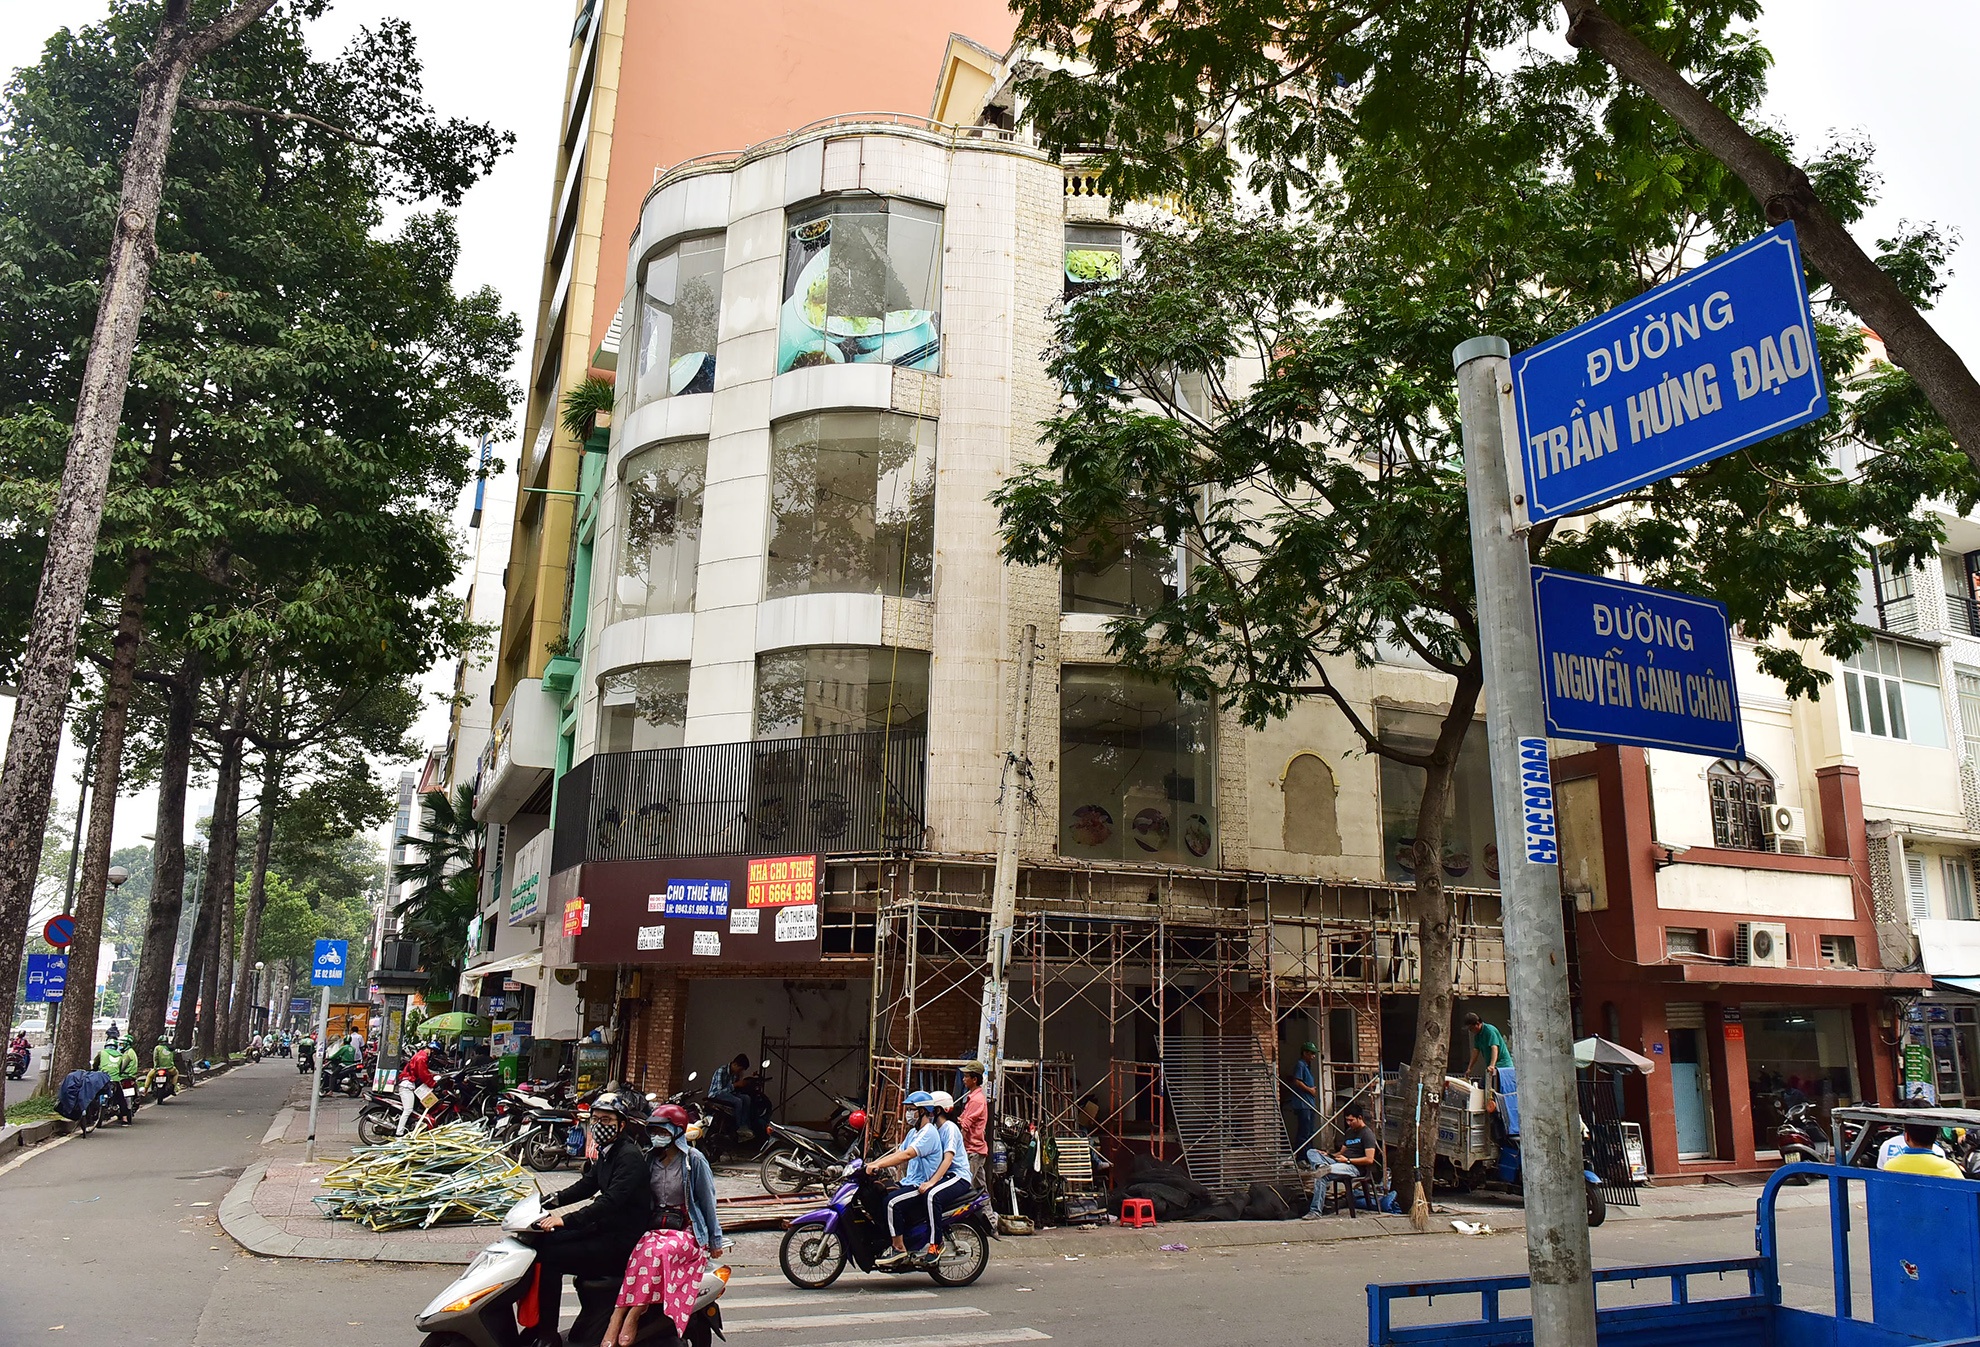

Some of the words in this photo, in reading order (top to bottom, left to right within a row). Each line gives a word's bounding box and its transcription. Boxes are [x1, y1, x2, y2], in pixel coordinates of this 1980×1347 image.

[1586, 290, 1735, 387] ĐƯỜNG
[1530, 398, 1618, 480] TRẦN
[1626, 363, 1723, 446] HƯNG
[1730, 324, 1810, 401] ĐẠO
[1593, 602, 1694, 651] ĐƯỜNG
[1552, 646, 1633, 708] NGUYỄN
[1636, 649, 1685, 716] CẢNH
[1685, 668, 1732, 723] CHÂN
[750, 859, 768, 881] NHÀ
[770, 861, 788, 880] CHO
[790, 856, 814, 879] THUÊ
[667, 885, 685, 901] CHO
[687, 882, 709, 901] THUÊ
[710, 882, 728, 902] NHÀ
[749, 885, 765, 904] 091
[769, 883, 792, 903] 6664
[794, 882, 813, 901] 999
[314, 969, 321, 978] XE
